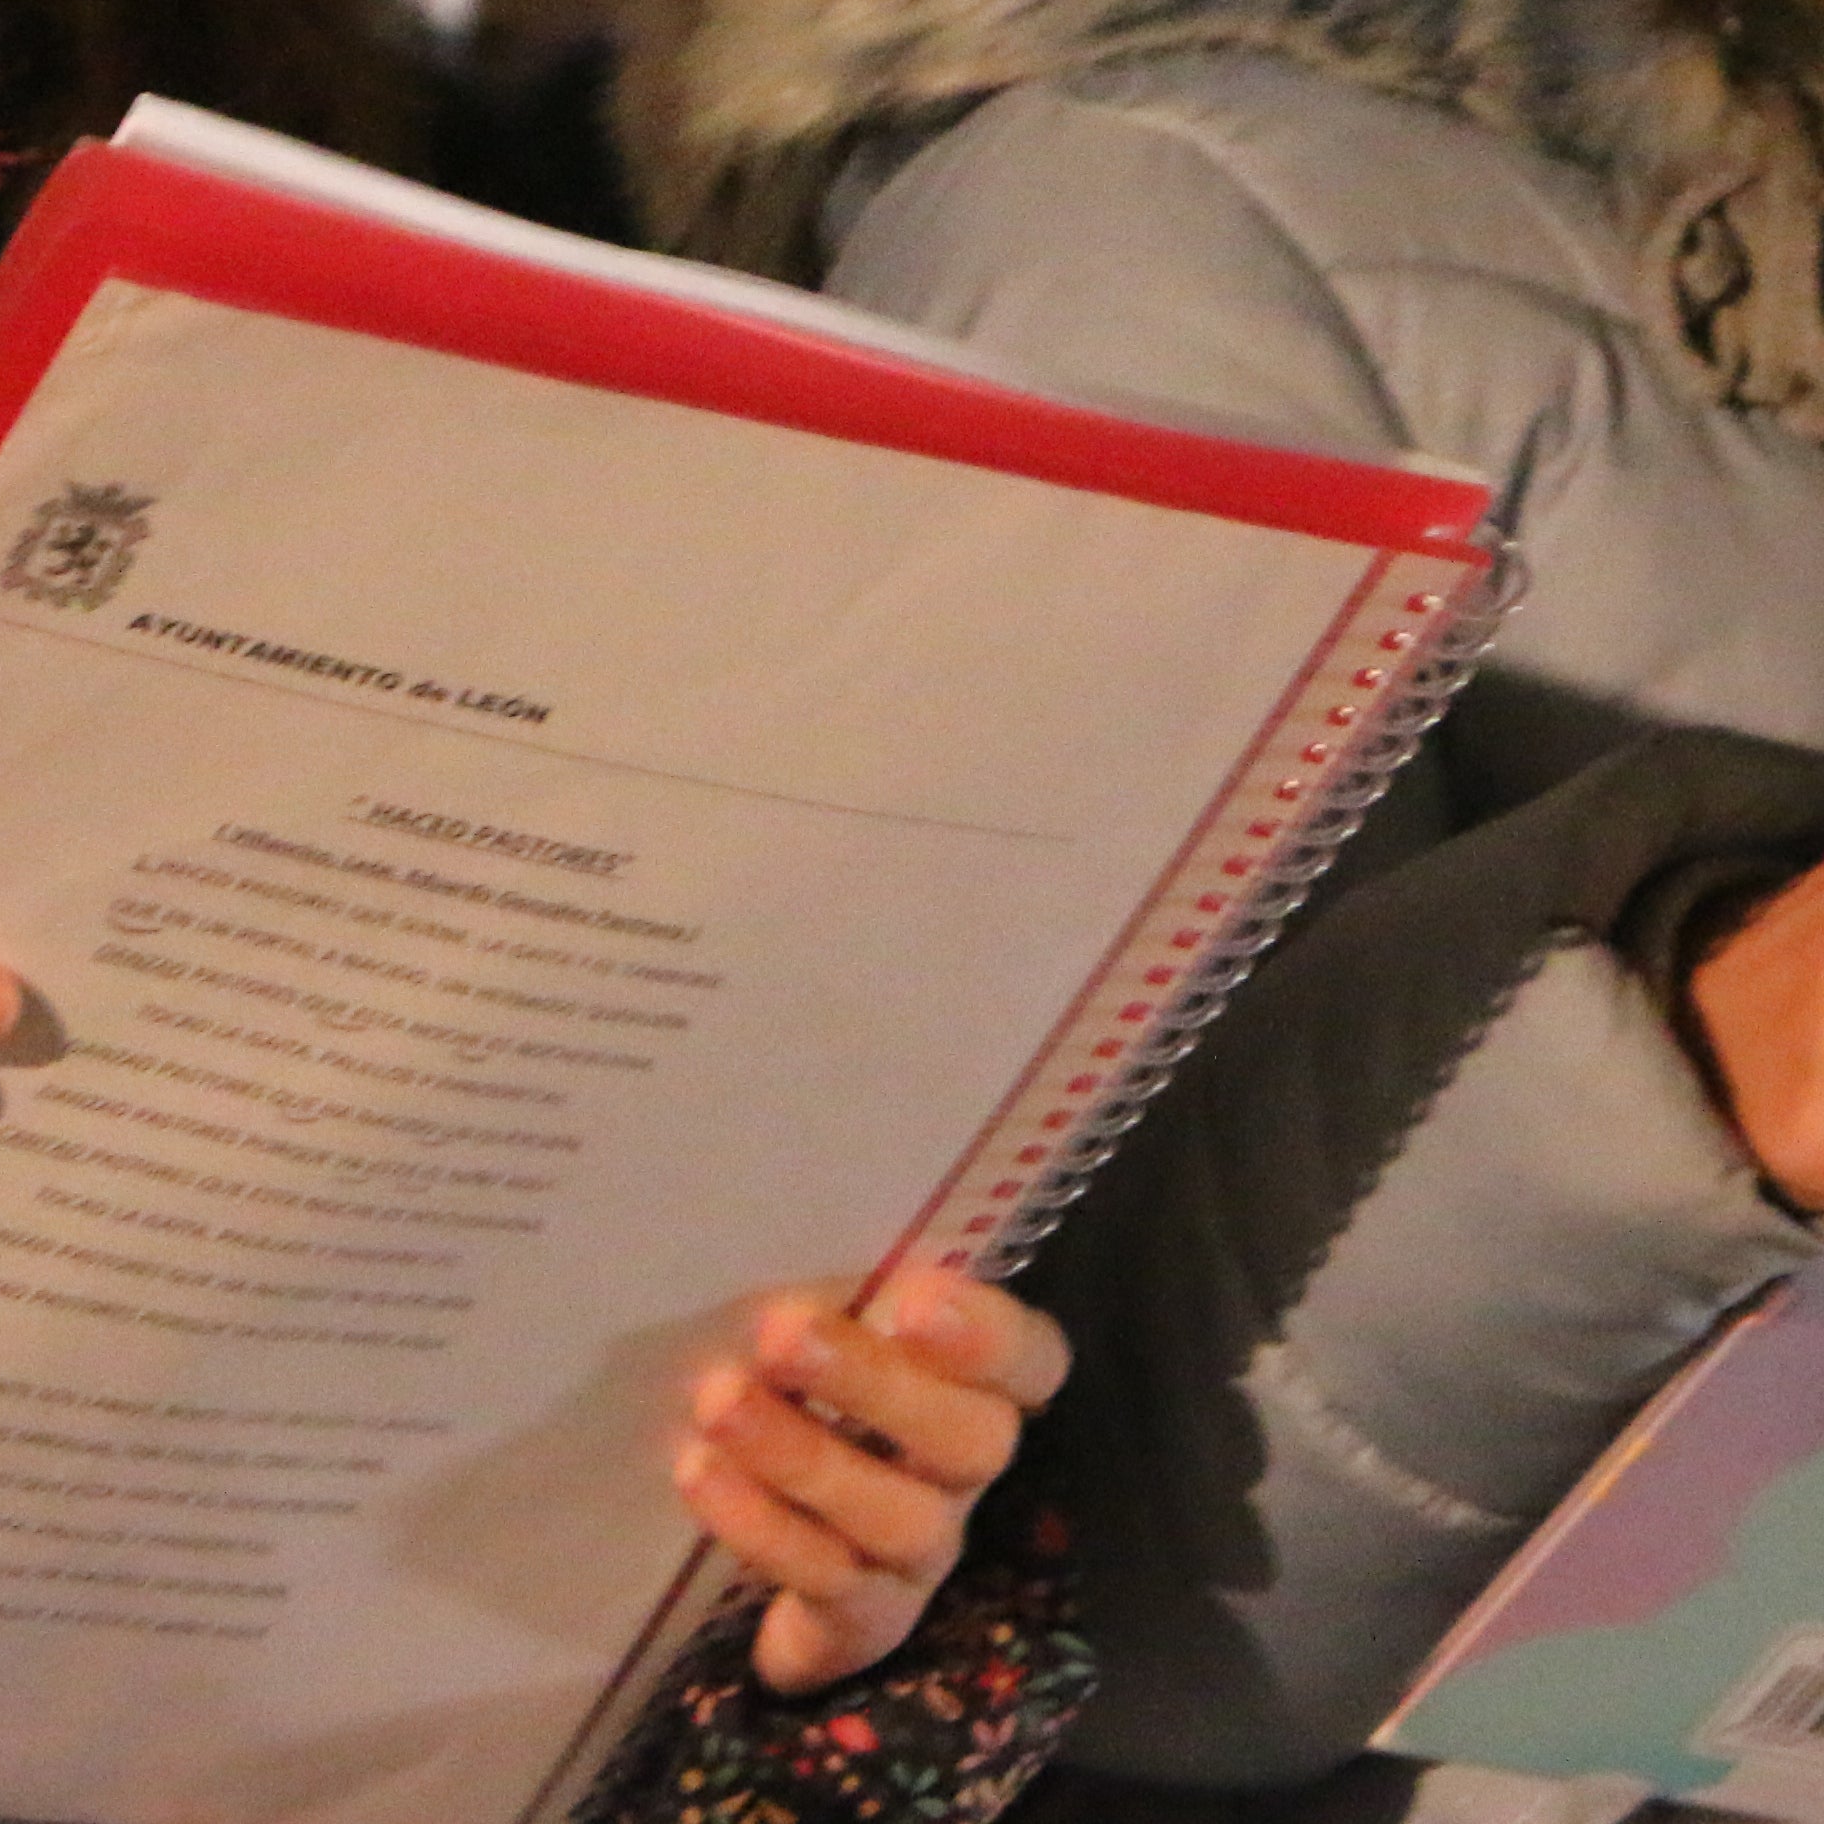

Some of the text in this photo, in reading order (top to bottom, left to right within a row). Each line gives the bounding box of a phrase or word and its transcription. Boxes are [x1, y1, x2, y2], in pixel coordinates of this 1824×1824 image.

[129, 614, 550, 723] AYUNTAMIENTO de LEÓN
